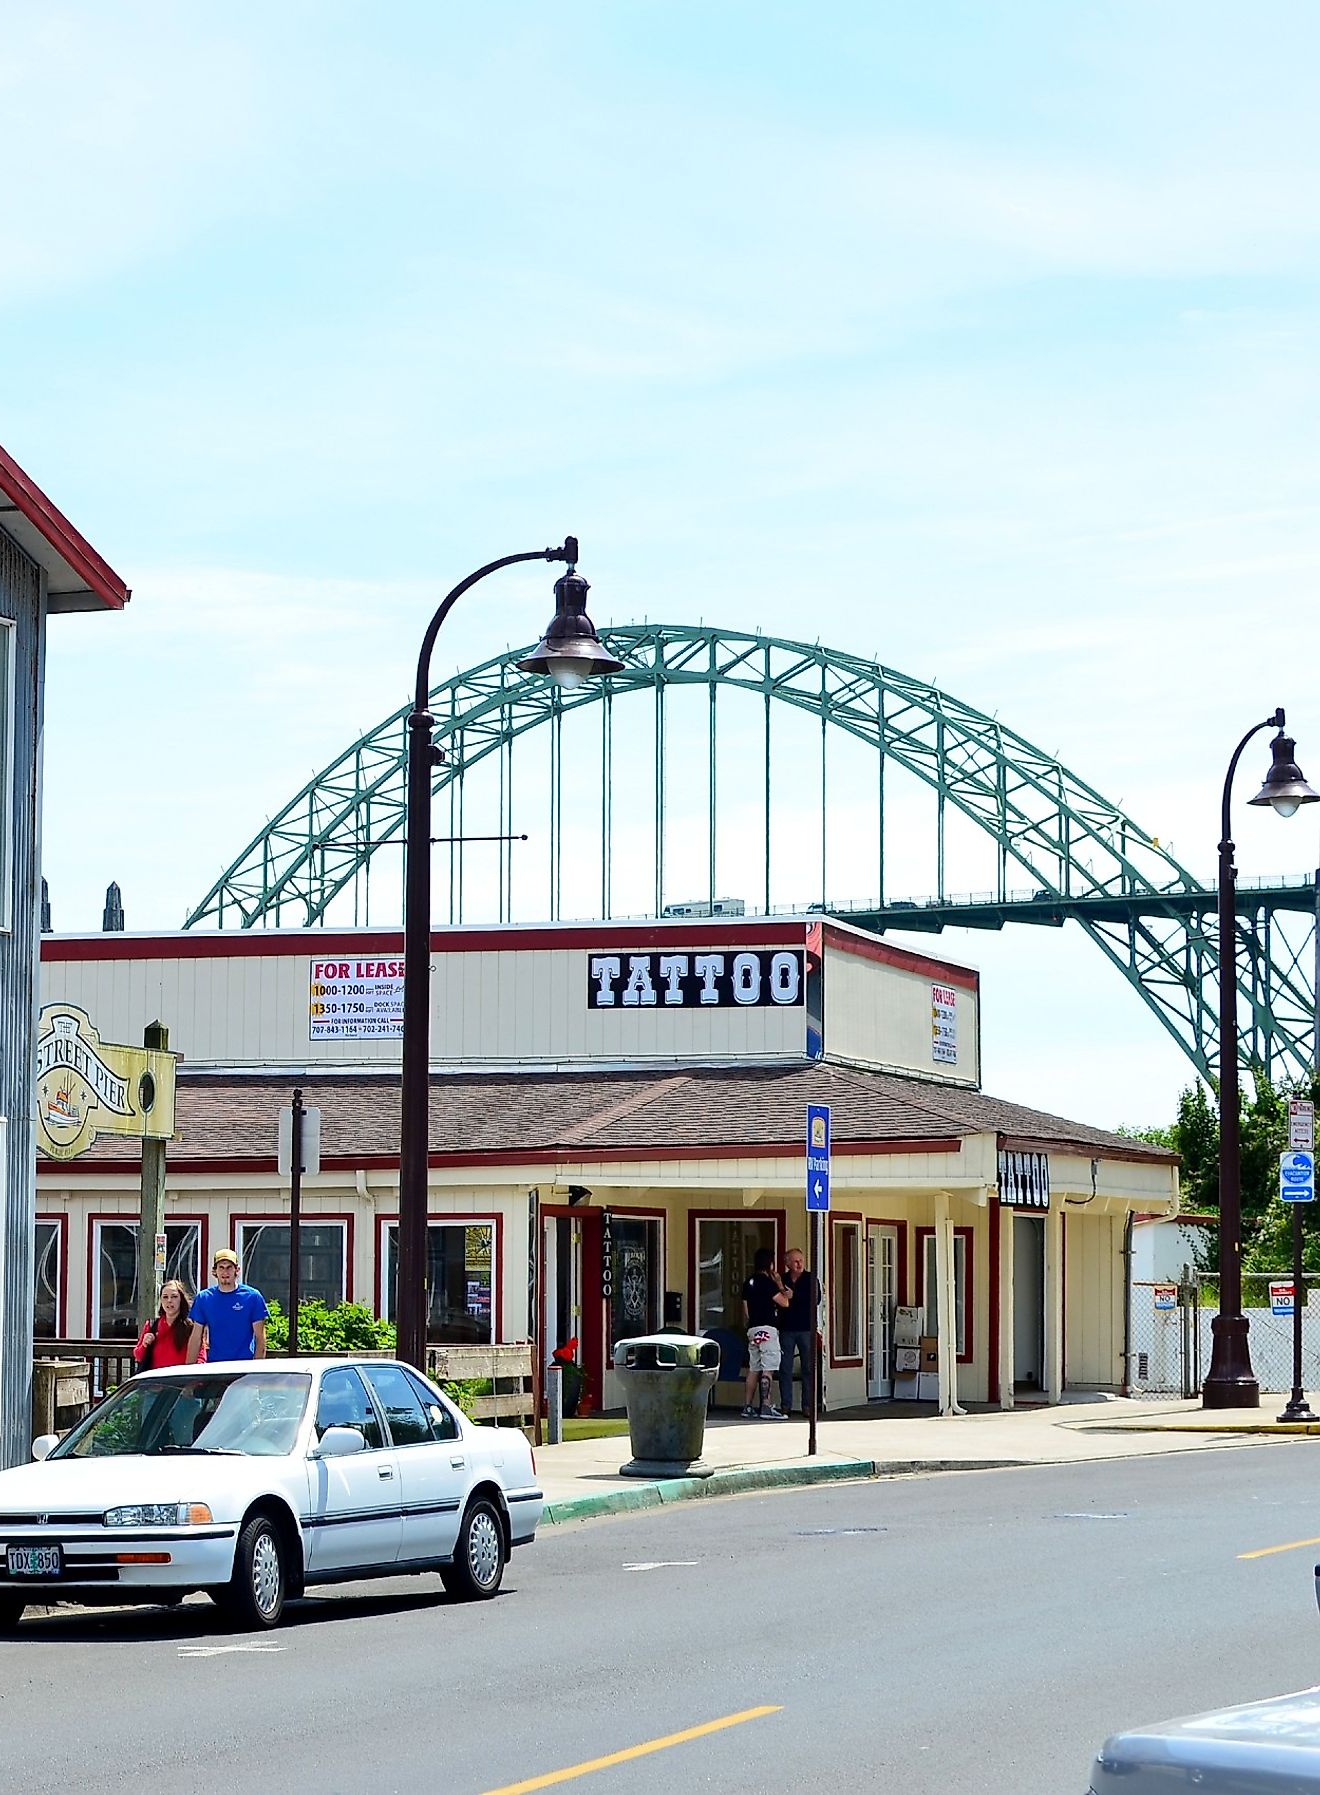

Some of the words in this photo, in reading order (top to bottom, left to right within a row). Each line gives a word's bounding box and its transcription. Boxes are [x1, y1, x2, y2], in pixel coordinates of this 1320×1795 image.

[314, 963, 351, 979] FOR
[591, 951, 801, 1006] TATTOO
[314, 984, 365, 996] 1000-1200
[313, 1003, 365, 1014] 1350-1750
[93, 1062, 126, 1110] PIER
[998, 1150, 1049, 1208] TATTOO
[602, 1213, 613, 1296] TATTOO
[1276, 1297, 1291, 1305] NO
[37, 1552, 59, 1570] 850
